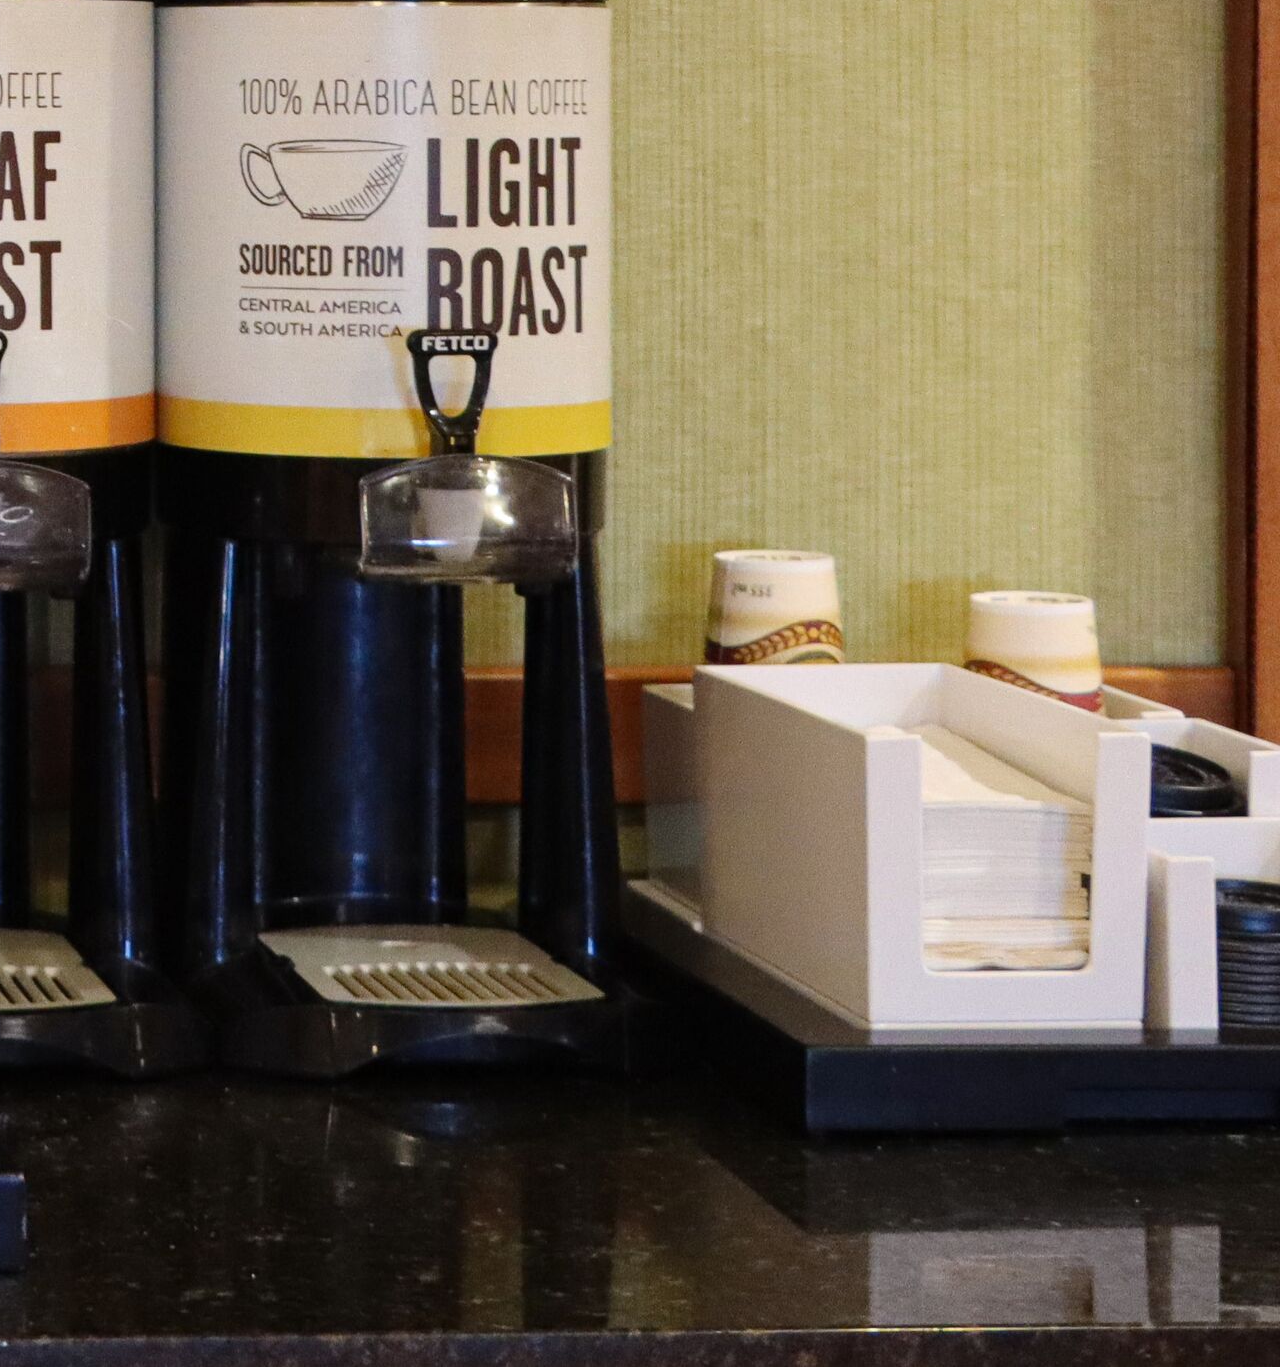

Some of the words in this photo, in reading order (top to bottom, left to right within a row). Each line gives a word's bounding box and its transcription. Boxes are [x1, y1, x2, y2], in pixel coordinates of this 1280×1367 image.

[239, 79, 302, 115] 100%
[312, 79, 438, 116] ARABICA
[451, 79, 516, 115] BEAN
[527, 79, 588, 115] COFFEE
[427, 137, 581, 228] LIGHT
[239, 243, 333, 278] SOURCED
[343, 245, 404, 278] FROM
[238, 297, 316, 314] CENTRAL
[319, 300, 402, 315] AMERICA
[427, 244, 587, 336] ROAST
[239, 320, 250, 334] &
[253, 320, 313, 336] SOUTH
[318, 323, 404, 338] AMERICA
[421, 335, 490, 352] FETCO
